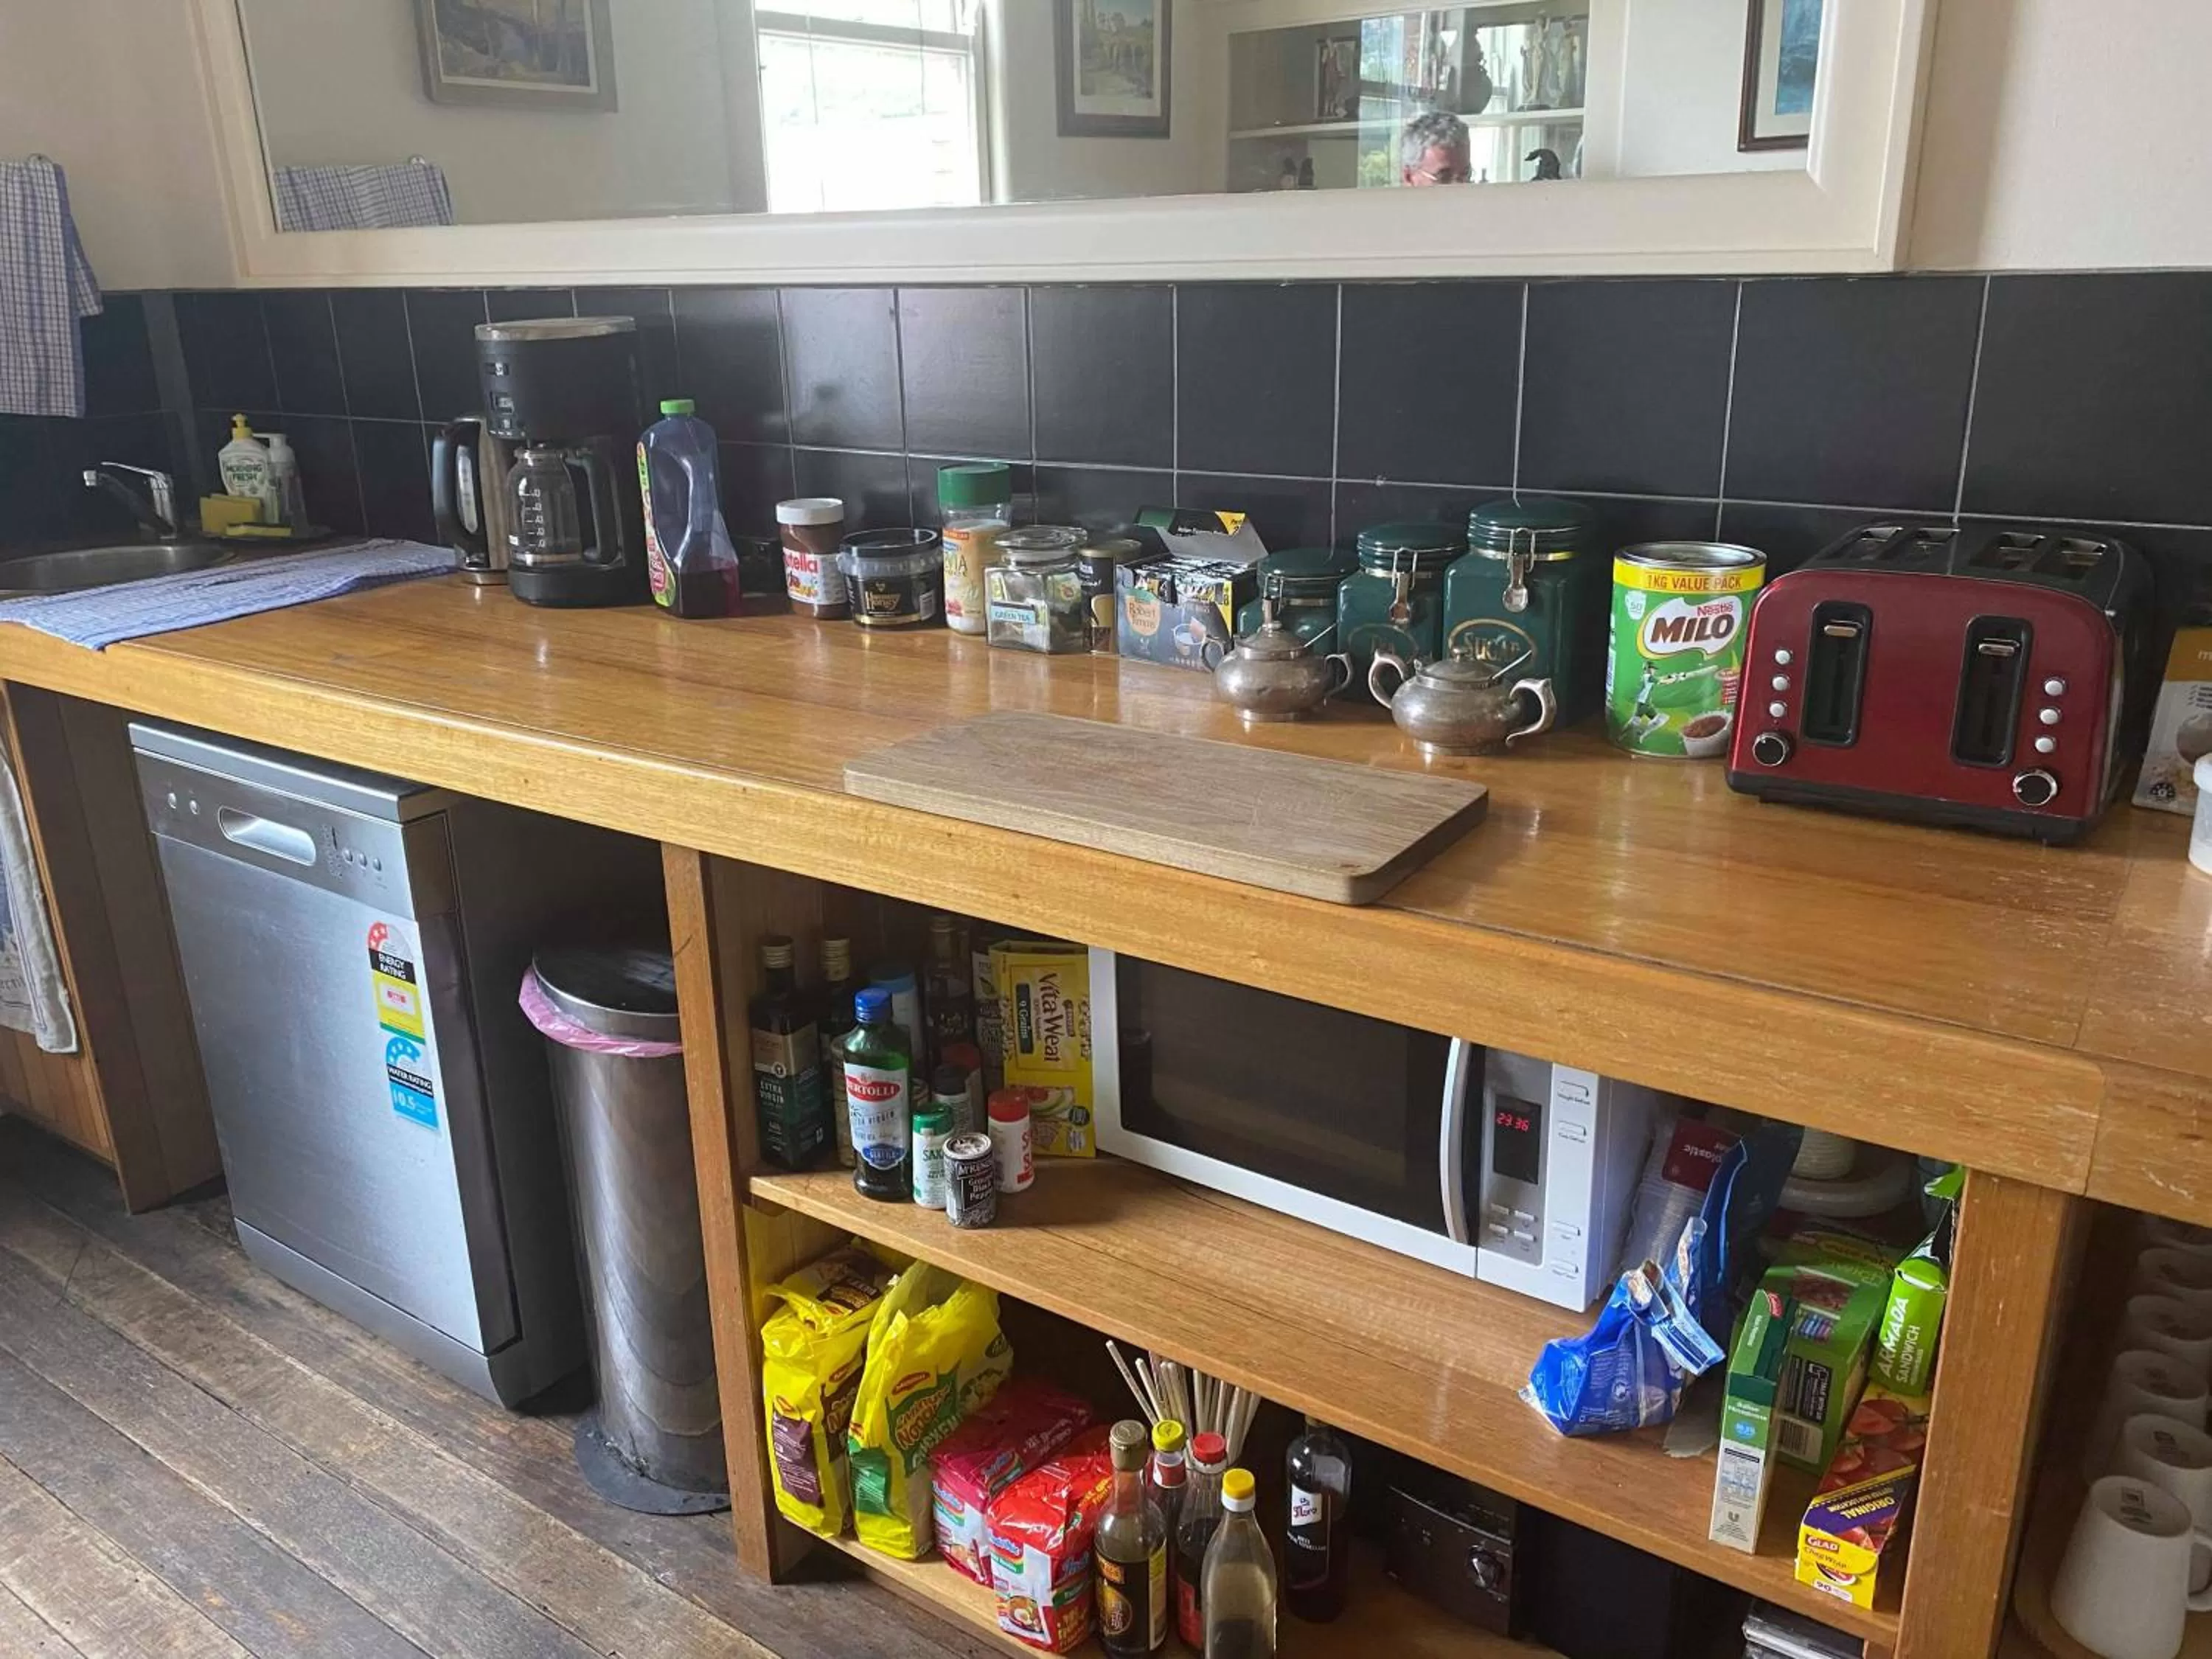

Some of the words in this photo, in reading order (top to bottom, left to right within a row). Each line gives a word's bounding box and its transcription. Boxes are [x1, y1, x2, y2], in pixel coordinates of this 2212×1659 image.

[1672, 577, 1709, 589] VALUE
[1714, 575, 1742, 589] PACK
[1649, 613, 1733, 644] MILO
[378, 952, 405, 970] ENERGY
[380, 962, 406, 980] RATING
[1877, 1297, 1909, 1379] ARMADA
[1896, 1324, 1921, 1384] SANDWICH
[1840, 1495, 1896, 1520] ORIGINAL
[1806, 1536, 1839, 1551] GLAD
